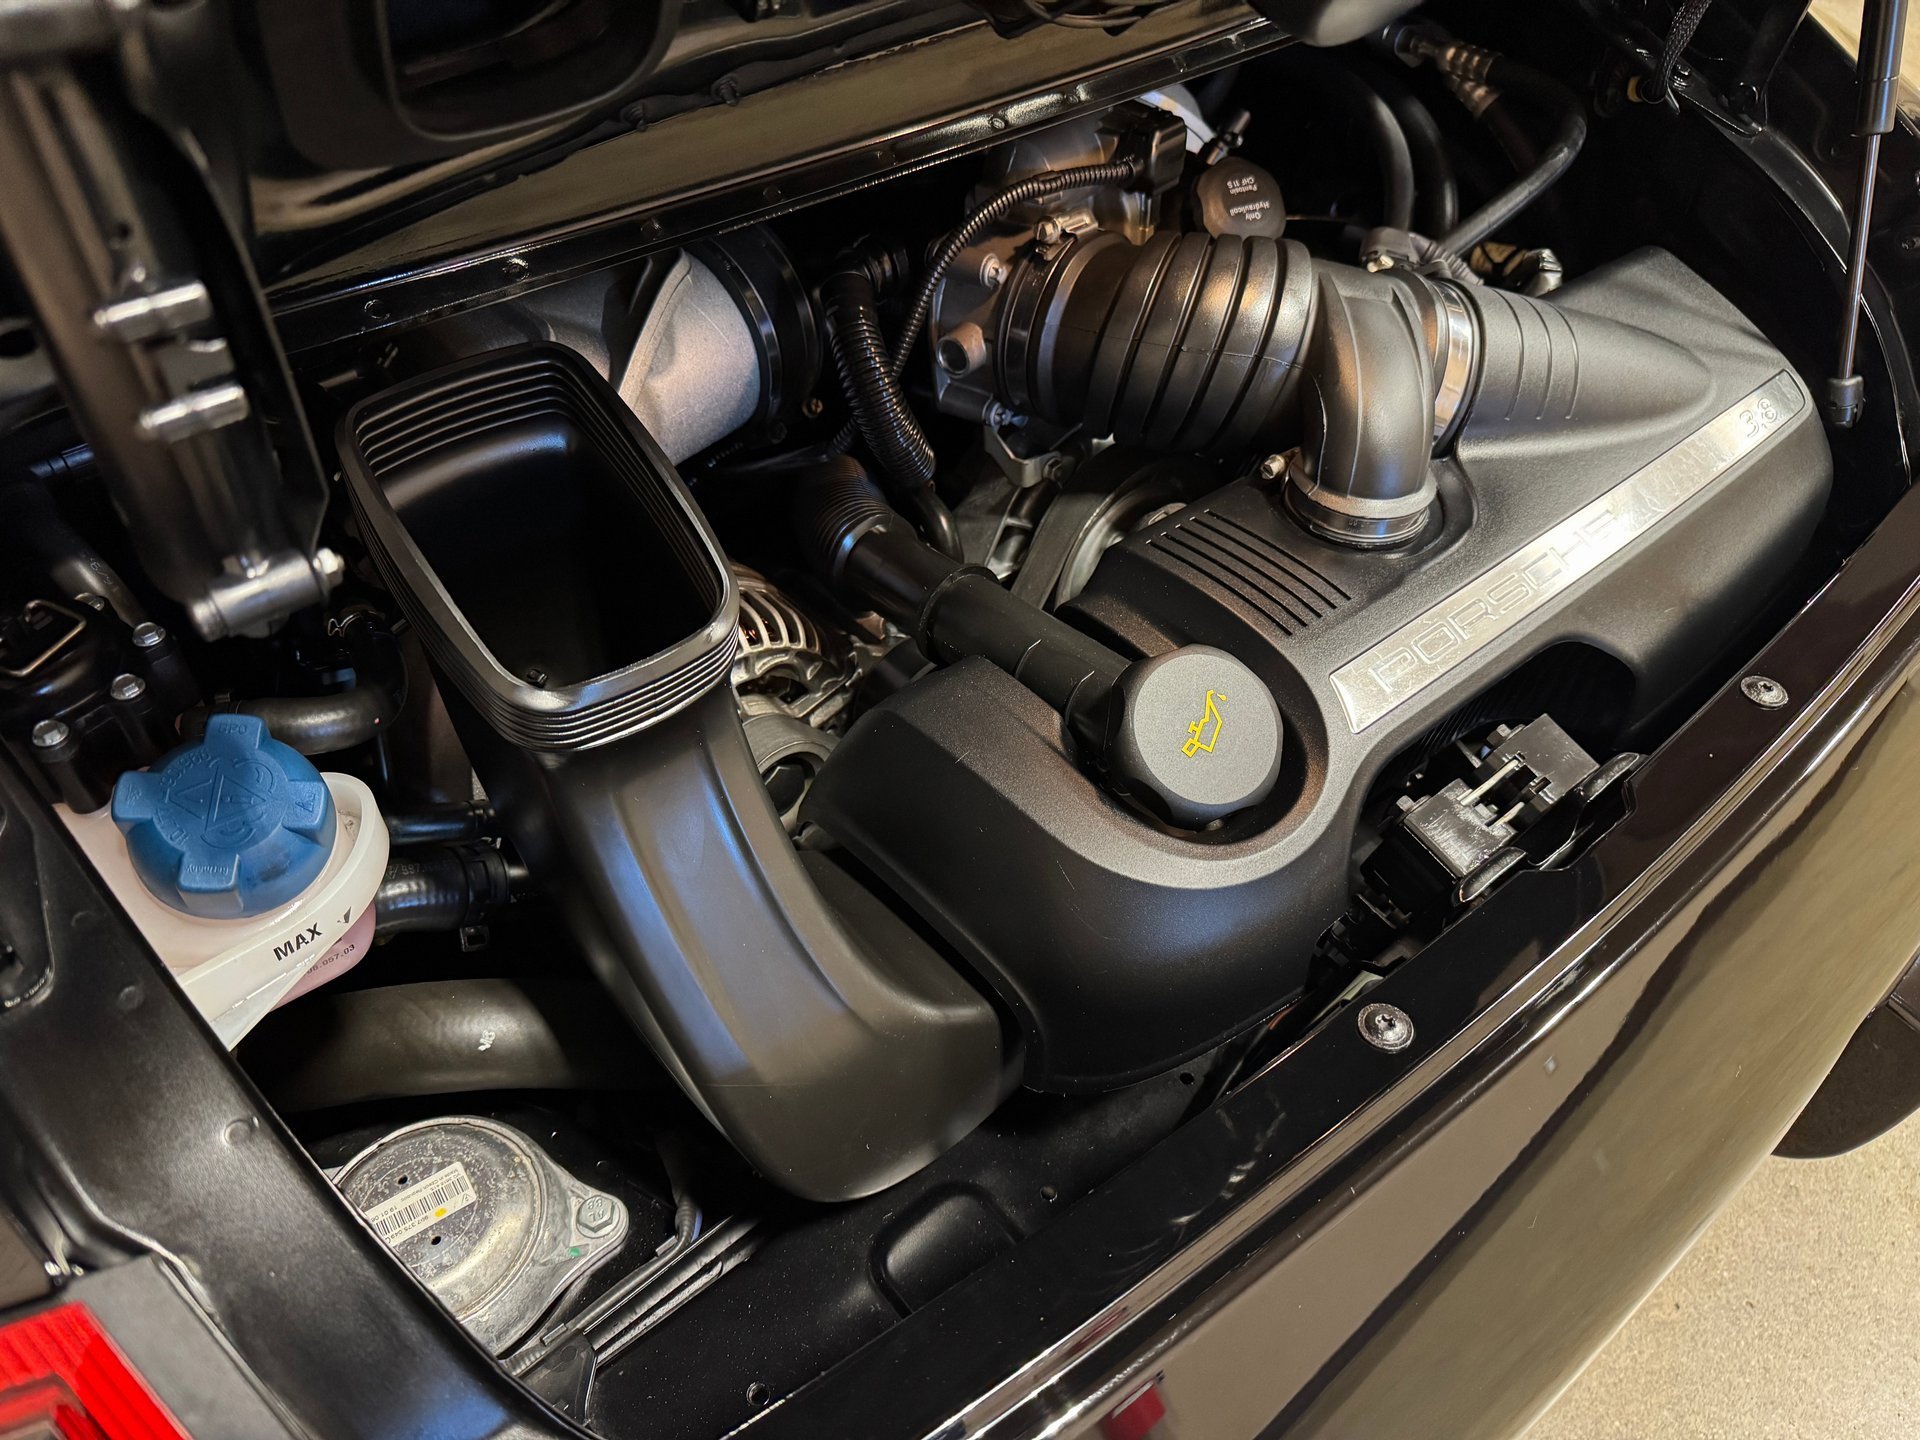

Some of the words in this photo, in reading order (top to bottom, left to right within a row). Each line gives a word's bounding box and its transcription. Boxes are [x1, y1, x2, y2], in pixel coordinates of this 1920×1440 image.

[1245, 212, 1261, 221] Only
[1367, 508, 1623, 694] PORSCHE
[273, 922, 323, 962] MAX
